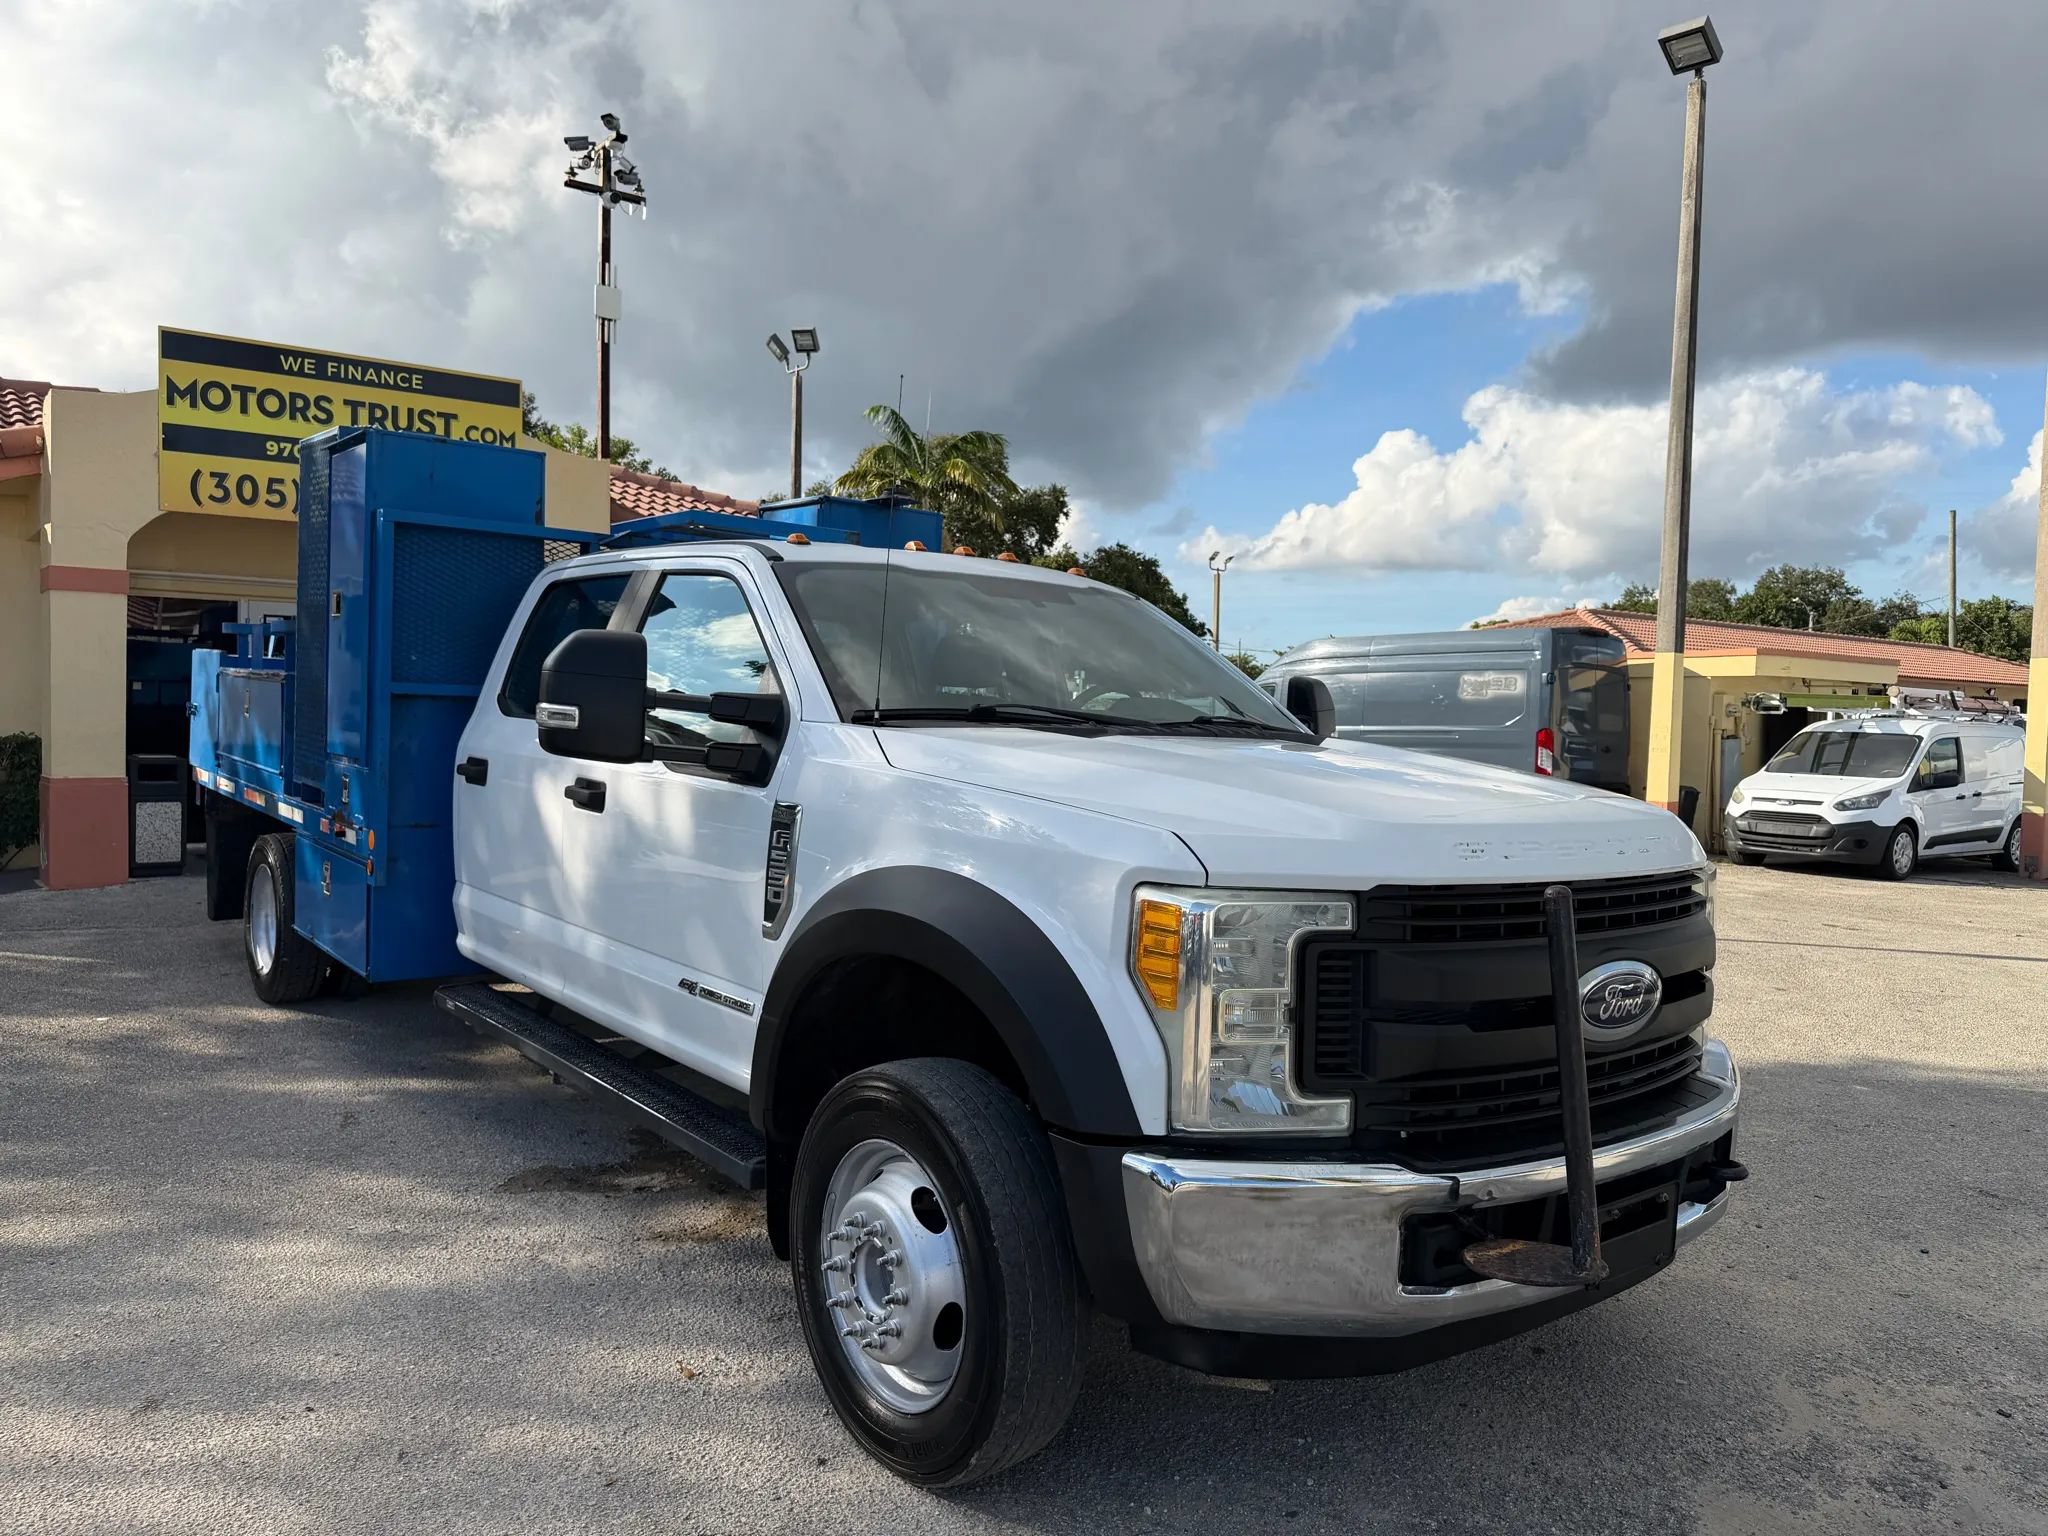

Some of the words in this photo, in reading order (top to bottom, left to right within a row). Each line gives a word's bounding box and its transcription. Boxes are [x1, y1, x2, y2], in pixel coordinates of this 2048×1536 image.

[280, 354, 316, 375] WE
[327, 361, 424, 390] FINANCE
[166, 375, 335, 425] MOTORS
[600, 982, 646, 1020] Ford
